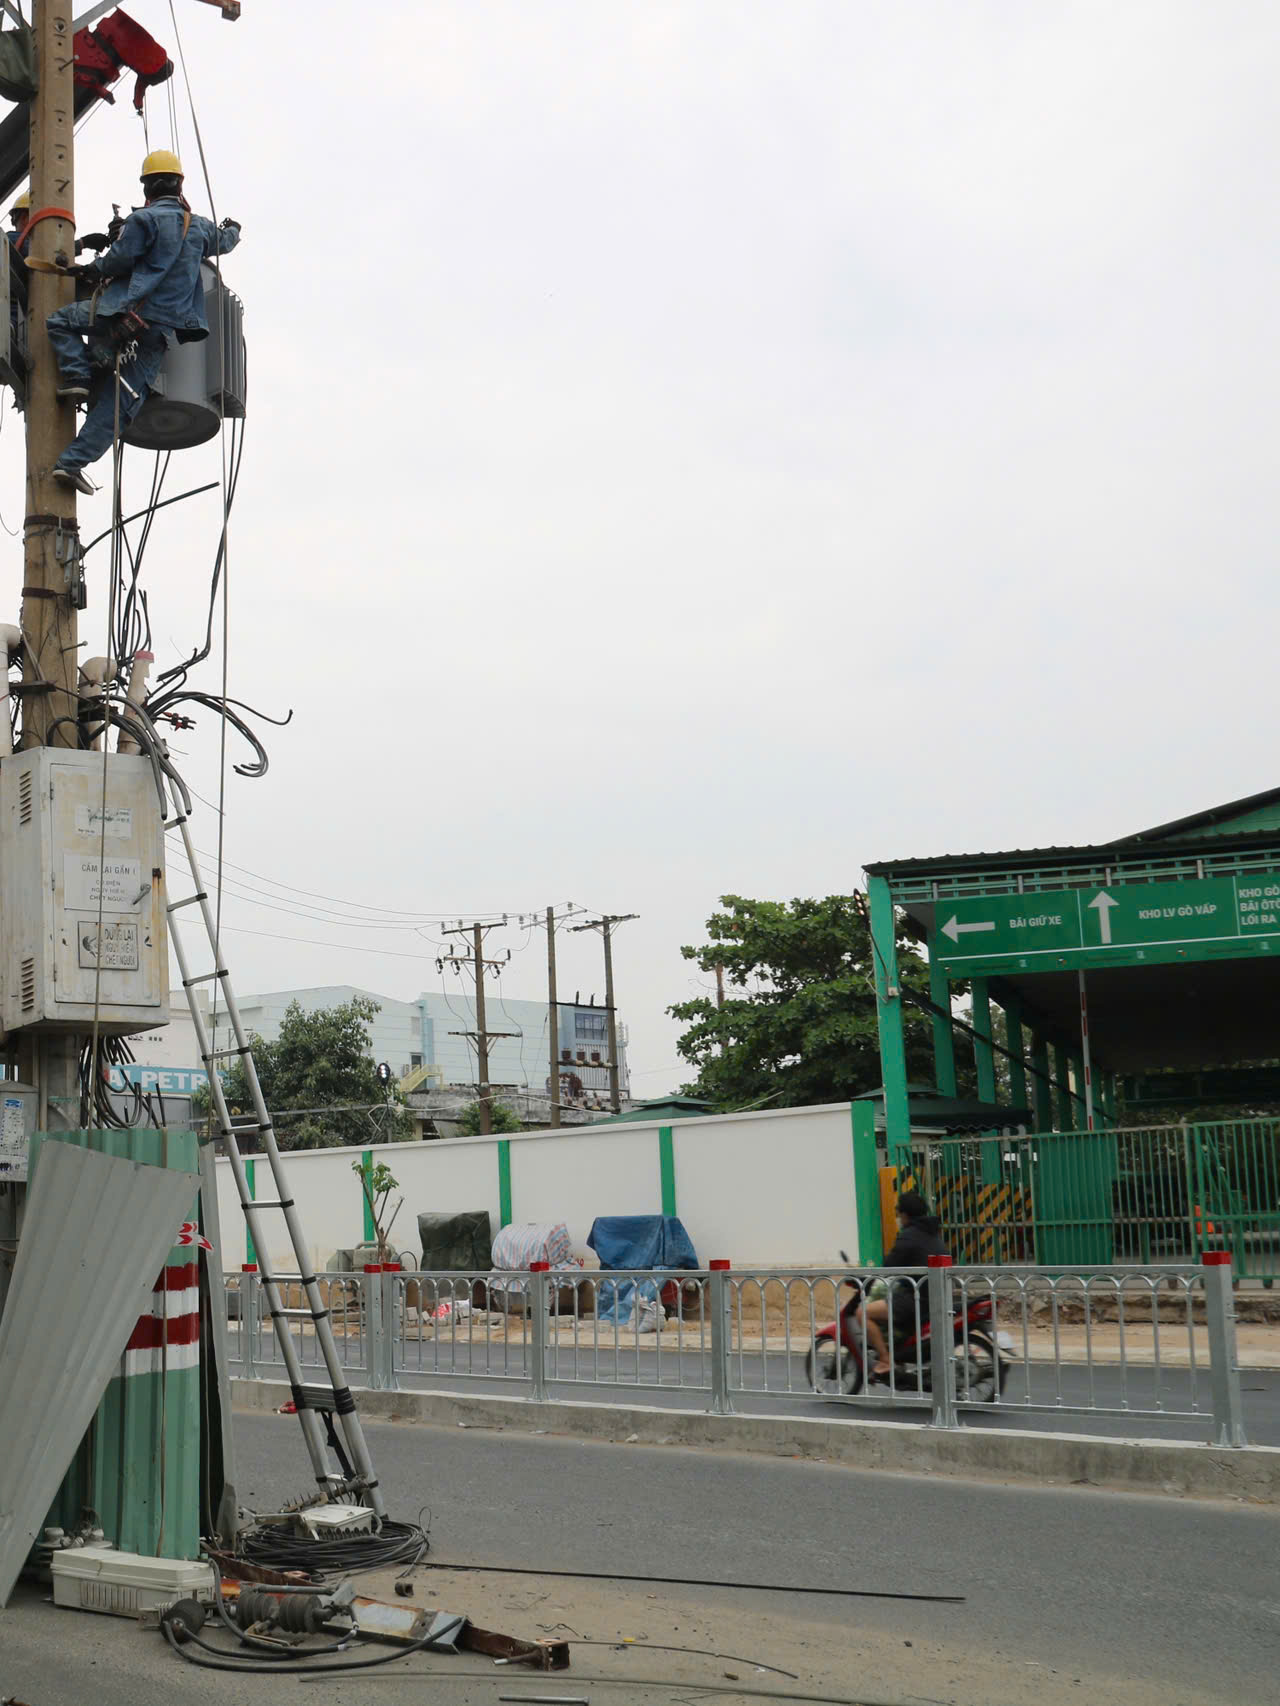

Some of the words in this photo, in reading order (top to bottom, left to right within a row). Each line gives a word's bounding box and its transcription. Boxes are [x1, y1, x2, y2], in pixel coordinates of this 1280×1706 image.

[1238, 887, 1262, 899] KHO
[1138, 908, 1161, 920] KHO
[1163, 906, 1176, 918] LV
[1177, 903, 1194, 917] GÒ
[1194, 903, 1217, 915] VẤP
[1048, 915, 1062, 926] XE
[1241, 913, 1259, 926] LỐI
[1261, 913, 1278, 924] RA
[109, 1069, 131, 1088] AI
